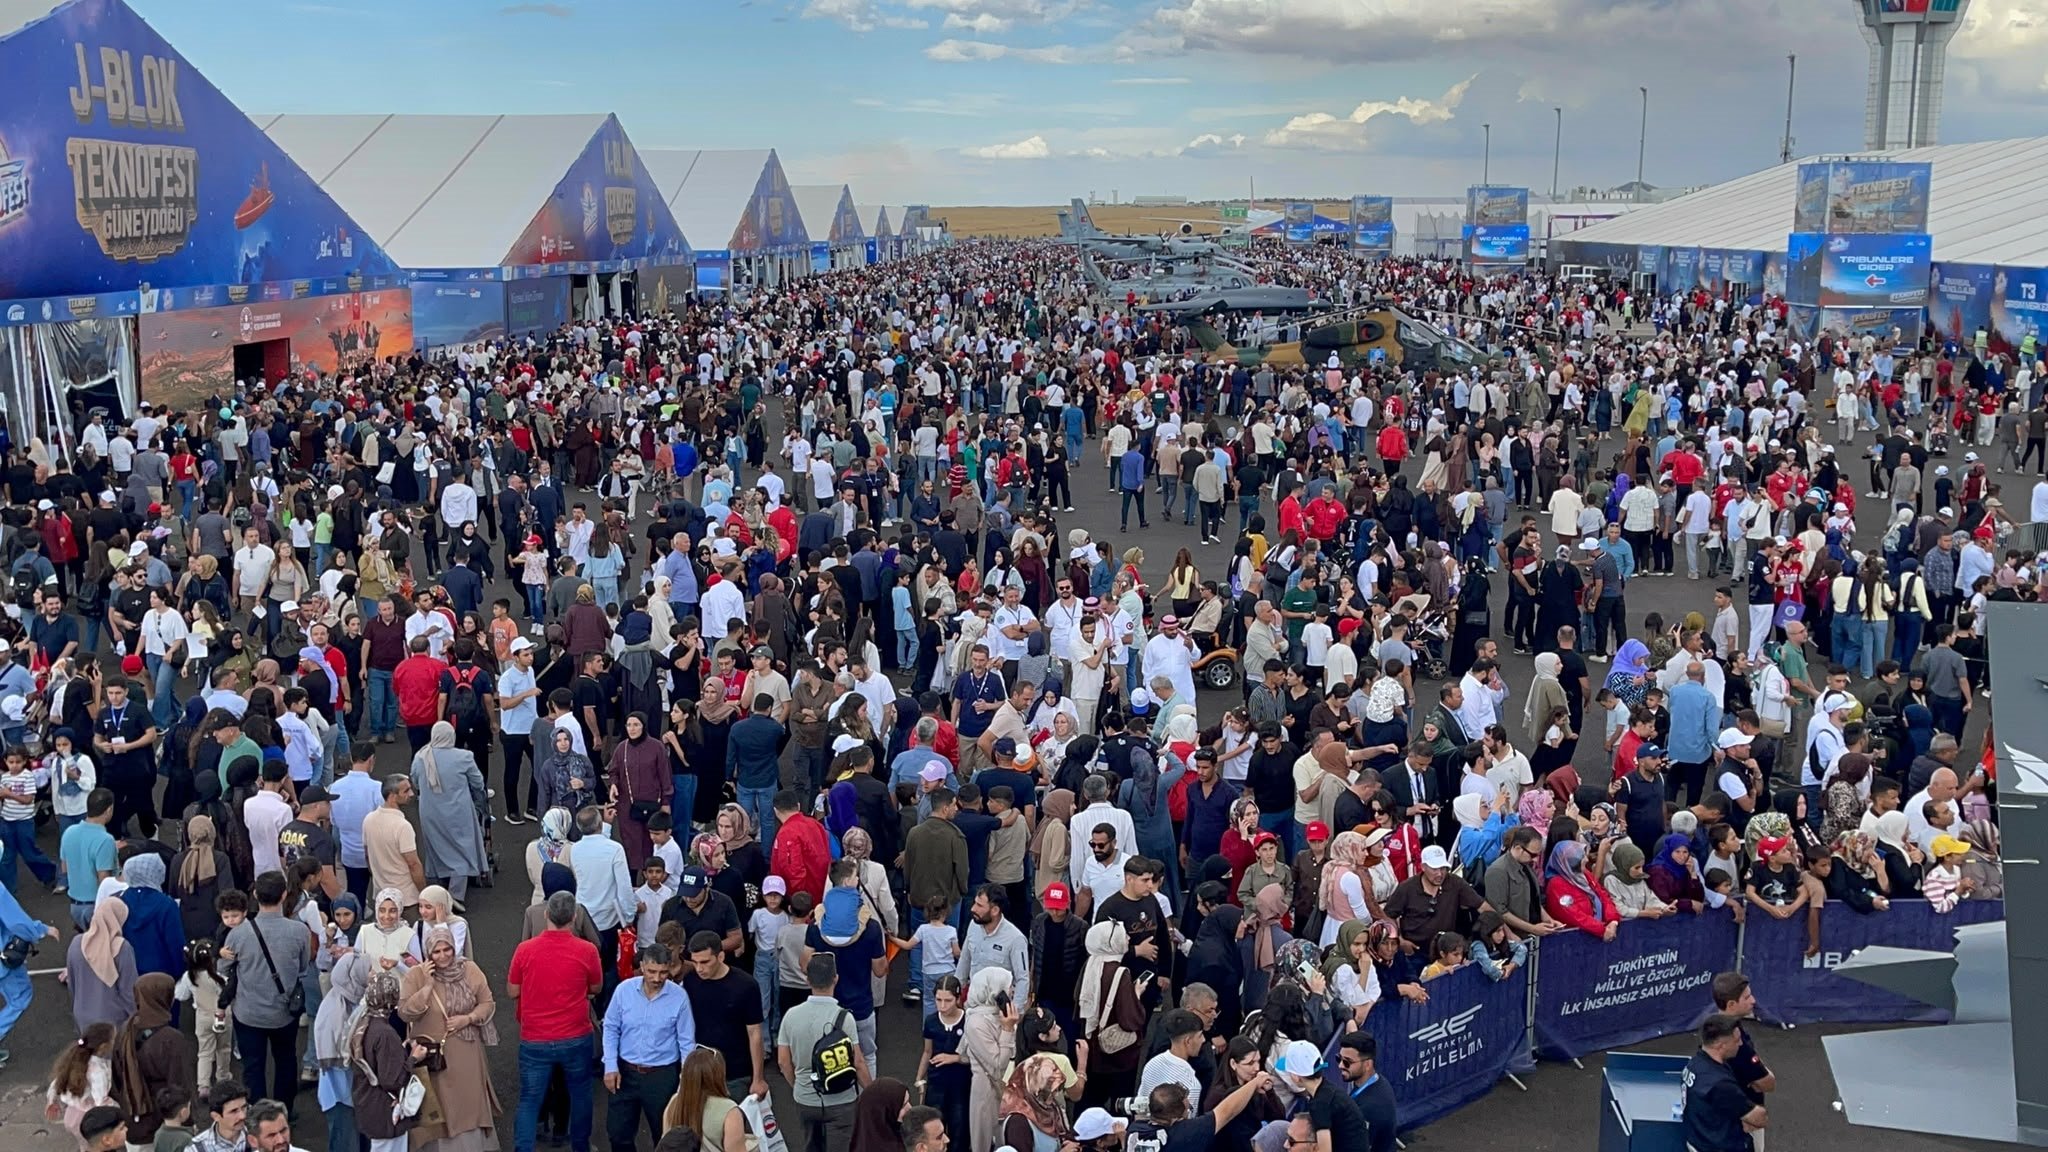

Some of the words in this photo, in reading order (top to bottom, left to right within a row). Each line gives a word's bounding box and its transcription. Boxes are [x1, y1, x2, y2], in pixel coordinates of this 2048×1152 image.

[69, 42, 184, 126] J-BLOK
[70, 143, 195, 199] TEKNOFEST
[1850, 176, 1912, 193] TEKNOFEST
[102, 203, 184, 240] GÜNEYDOĞU
[2021, 283, 2036, 299] T3
[1595, 974, 1628, 994] MİLLİ
[1630, 974, 1645, 986] VE
[1647, 963, 1687, 983] ÖZGÜN
[1608, 949, 1678, 976] TÜRKİYE'NİN
[1561, 1001, 1582, 1016] İLK
[1583, 991, 1637, 1011] İNSANSIZ
[1639, 981, 1676, 1000] SAVAŞ
[1678, 970, 1712, 991] UÇAĞI
[1406, 1037, 1483, 1081] KIZILELMA
[1420, 1031, 1472, 1059] BAYRAKTAR
